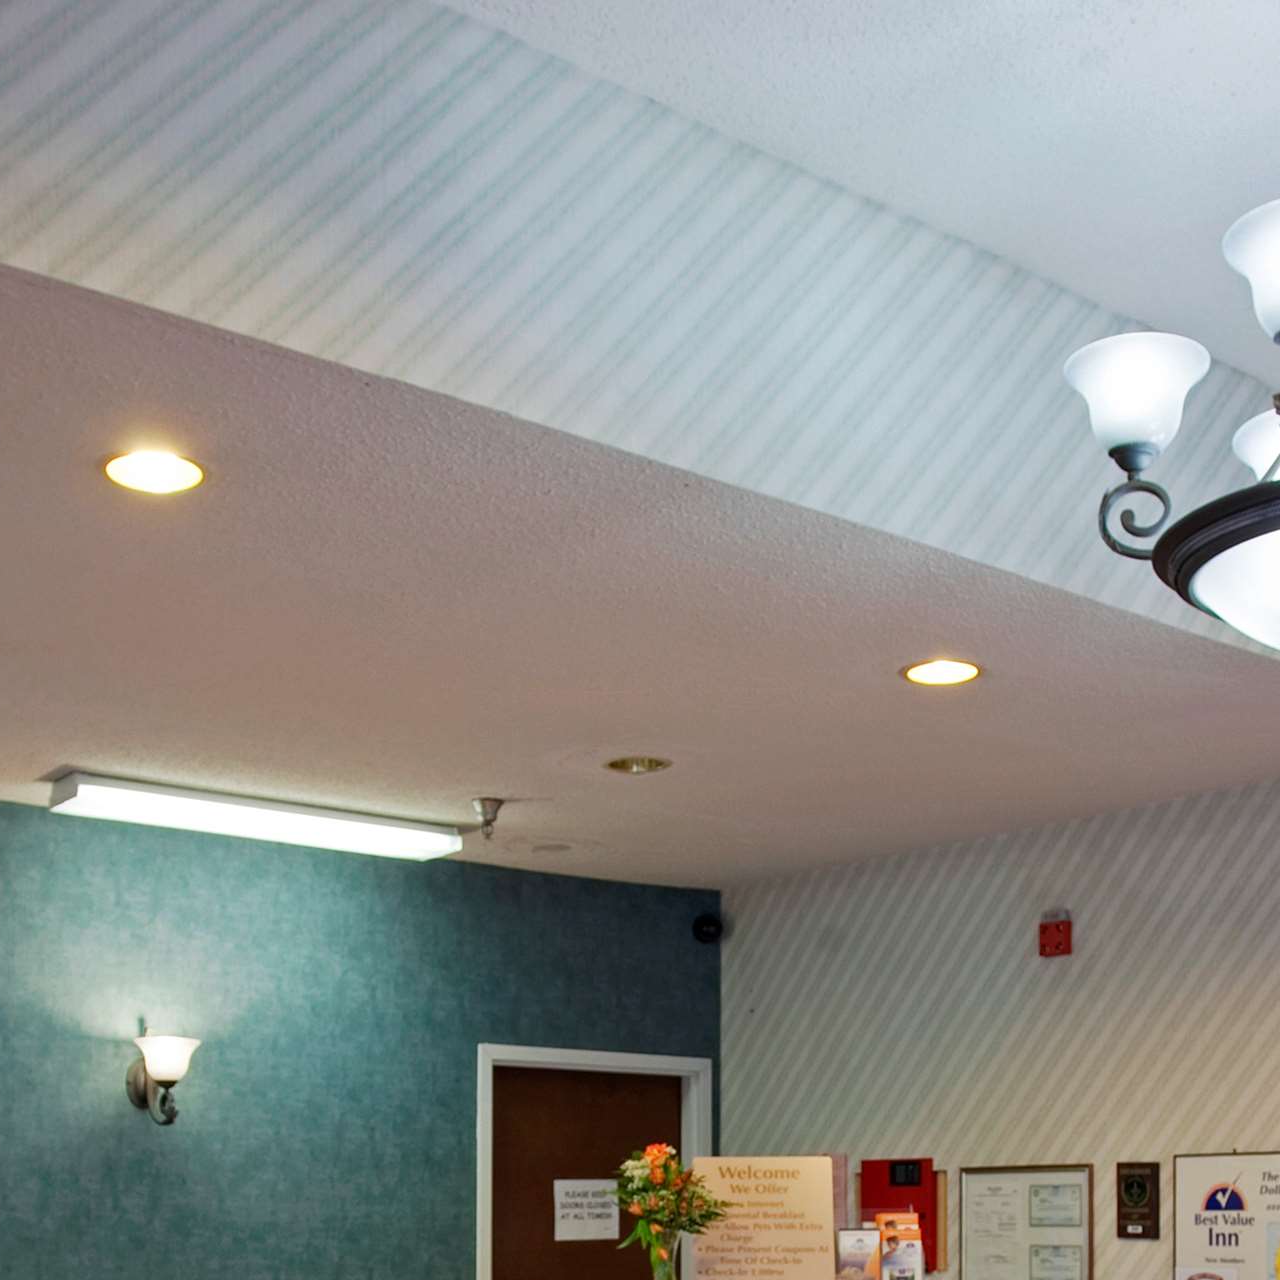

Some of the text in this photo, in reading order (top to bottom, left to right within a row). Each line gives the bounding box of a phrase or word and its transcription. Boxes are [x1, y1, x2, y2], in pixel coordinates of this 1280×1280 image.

[718, 1166, 801, 1180] Welcome
[1261, 1172, 1280, 1181] The
[730, 1183, 789, 1194] We Offer
[1194, 1213, 1255, 1226] Best Value
[721, 1234, 754, 1244] Charge
[1209, 1228, 1239, 1247] Inn
[705, 1245, 734, 1253] Please
[738, 1245, 771, 1253] Present
[720, 1256, 742, 1264] Time
[745, 1256, 757, 1264] Of
